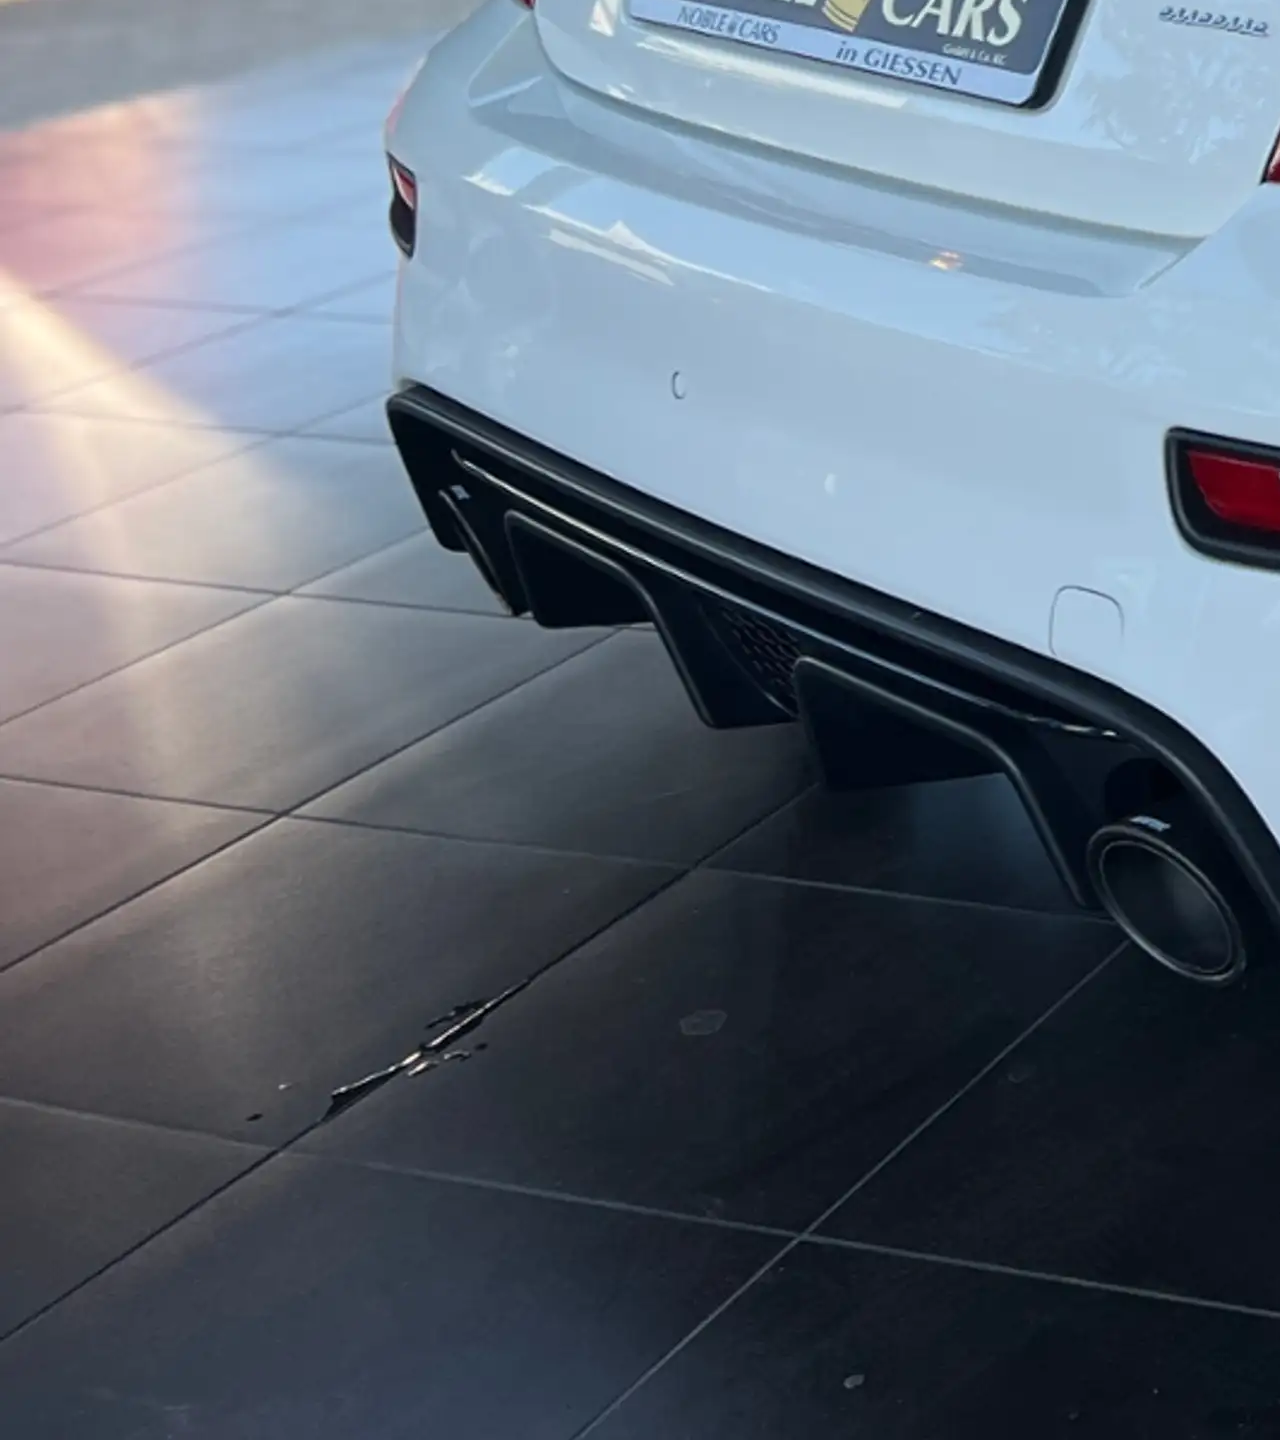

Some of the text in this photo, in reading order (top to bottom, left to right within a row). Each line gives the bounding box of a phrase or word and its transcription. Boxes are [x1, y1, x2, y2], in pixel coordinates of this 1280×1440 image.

[676, 5, 782, 45] NOBLE CARS
[835, 40, 963, 86] in GIESSEN
